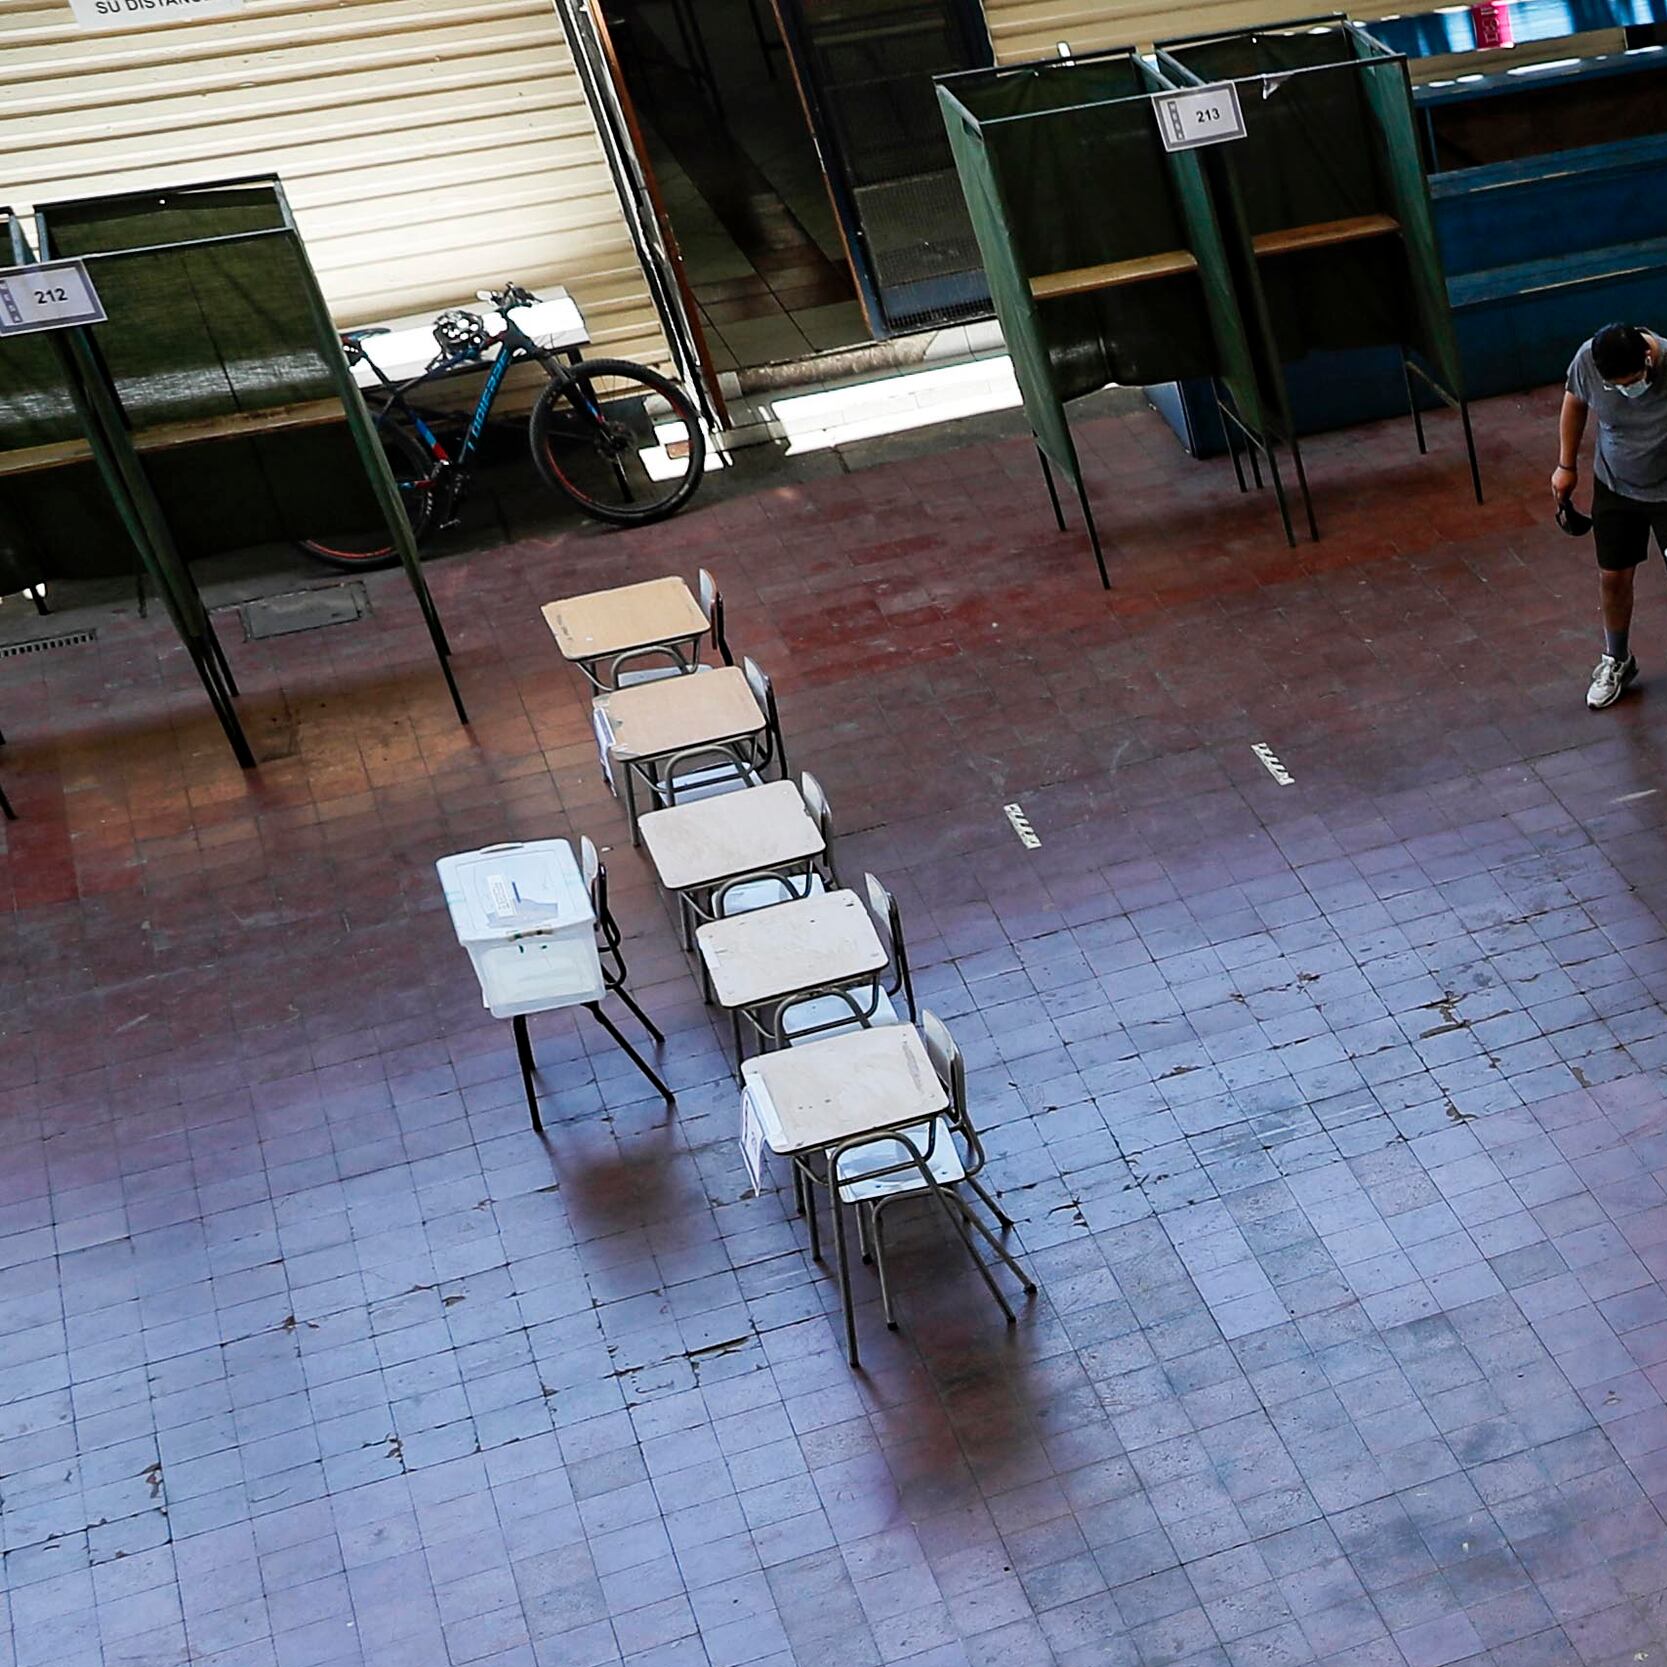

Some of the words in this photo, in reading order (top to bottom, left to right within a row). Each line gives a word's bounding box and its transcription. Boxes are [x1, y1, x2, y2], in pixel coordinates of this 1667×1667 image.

[95, 0, 121, 14] SU
[1196, 107, 1220, 123] 213
[34, 288, 68, 304] 212
